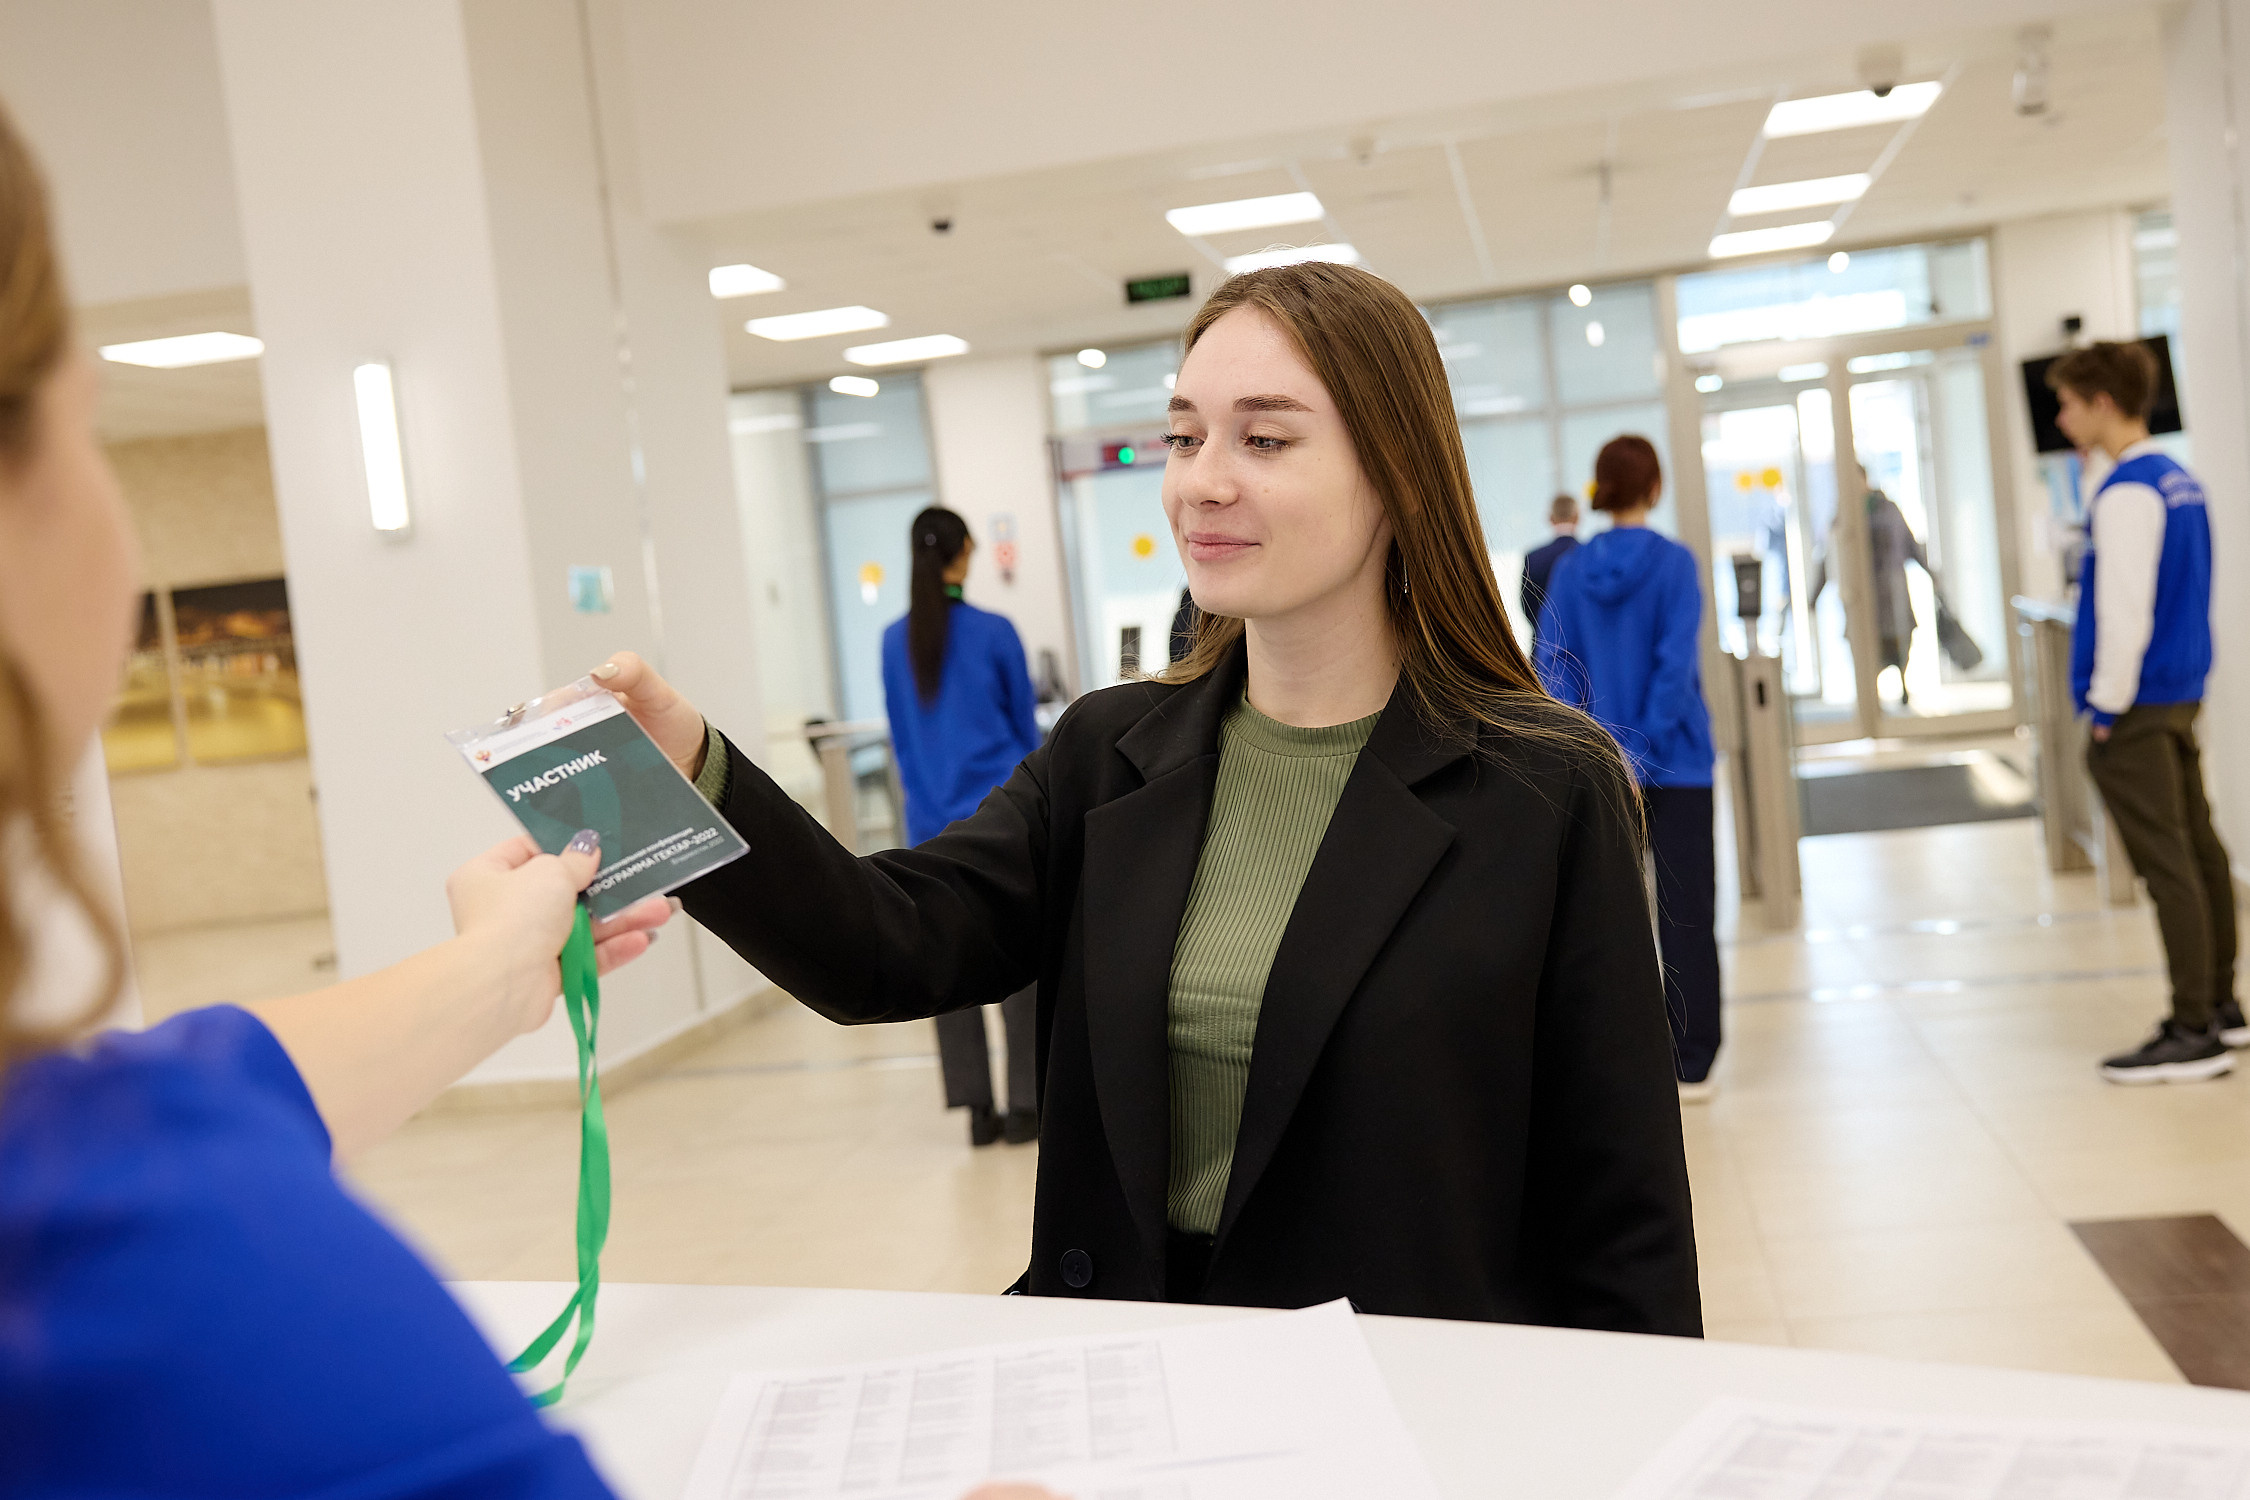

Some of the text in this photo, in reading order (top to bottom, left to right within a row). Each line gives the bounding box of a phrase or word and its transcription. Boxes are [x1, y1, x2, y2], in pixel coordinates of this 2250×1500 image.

[506, 750, 607, 802] УЧАСТНИК
[586, 857, 656, 897] ПРОГРАММА
[652, 827, 719, 862] ГЕКТАР-2022
